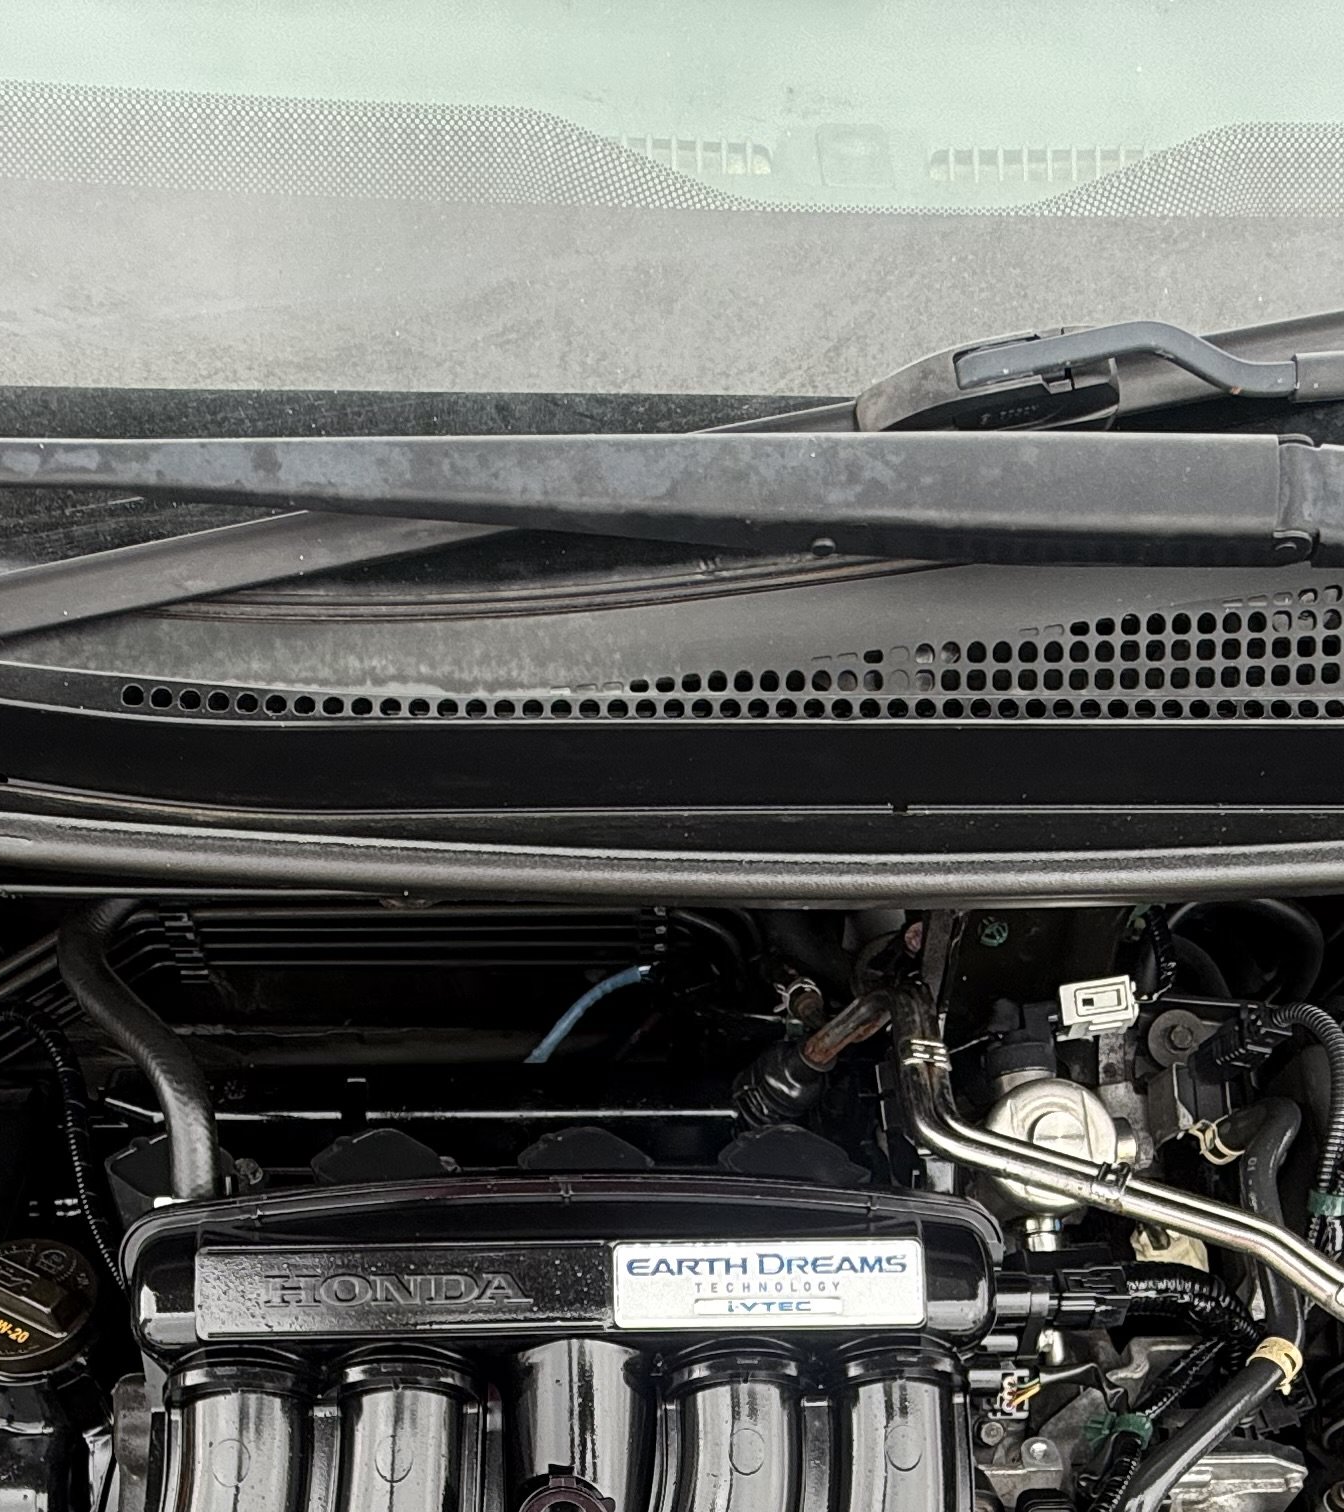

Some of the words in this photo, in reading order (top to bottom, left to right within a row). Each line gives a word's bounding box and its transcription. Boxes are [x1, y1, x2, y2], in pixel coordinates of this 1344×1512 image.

[626, 1257, 748, 1276] EARTH
[756, 1253, 908, 1275] DREAMS
[263, 1272, 534, 1308] HONDA
[695, 1281, 841, 1293] TECHNOLOGY
